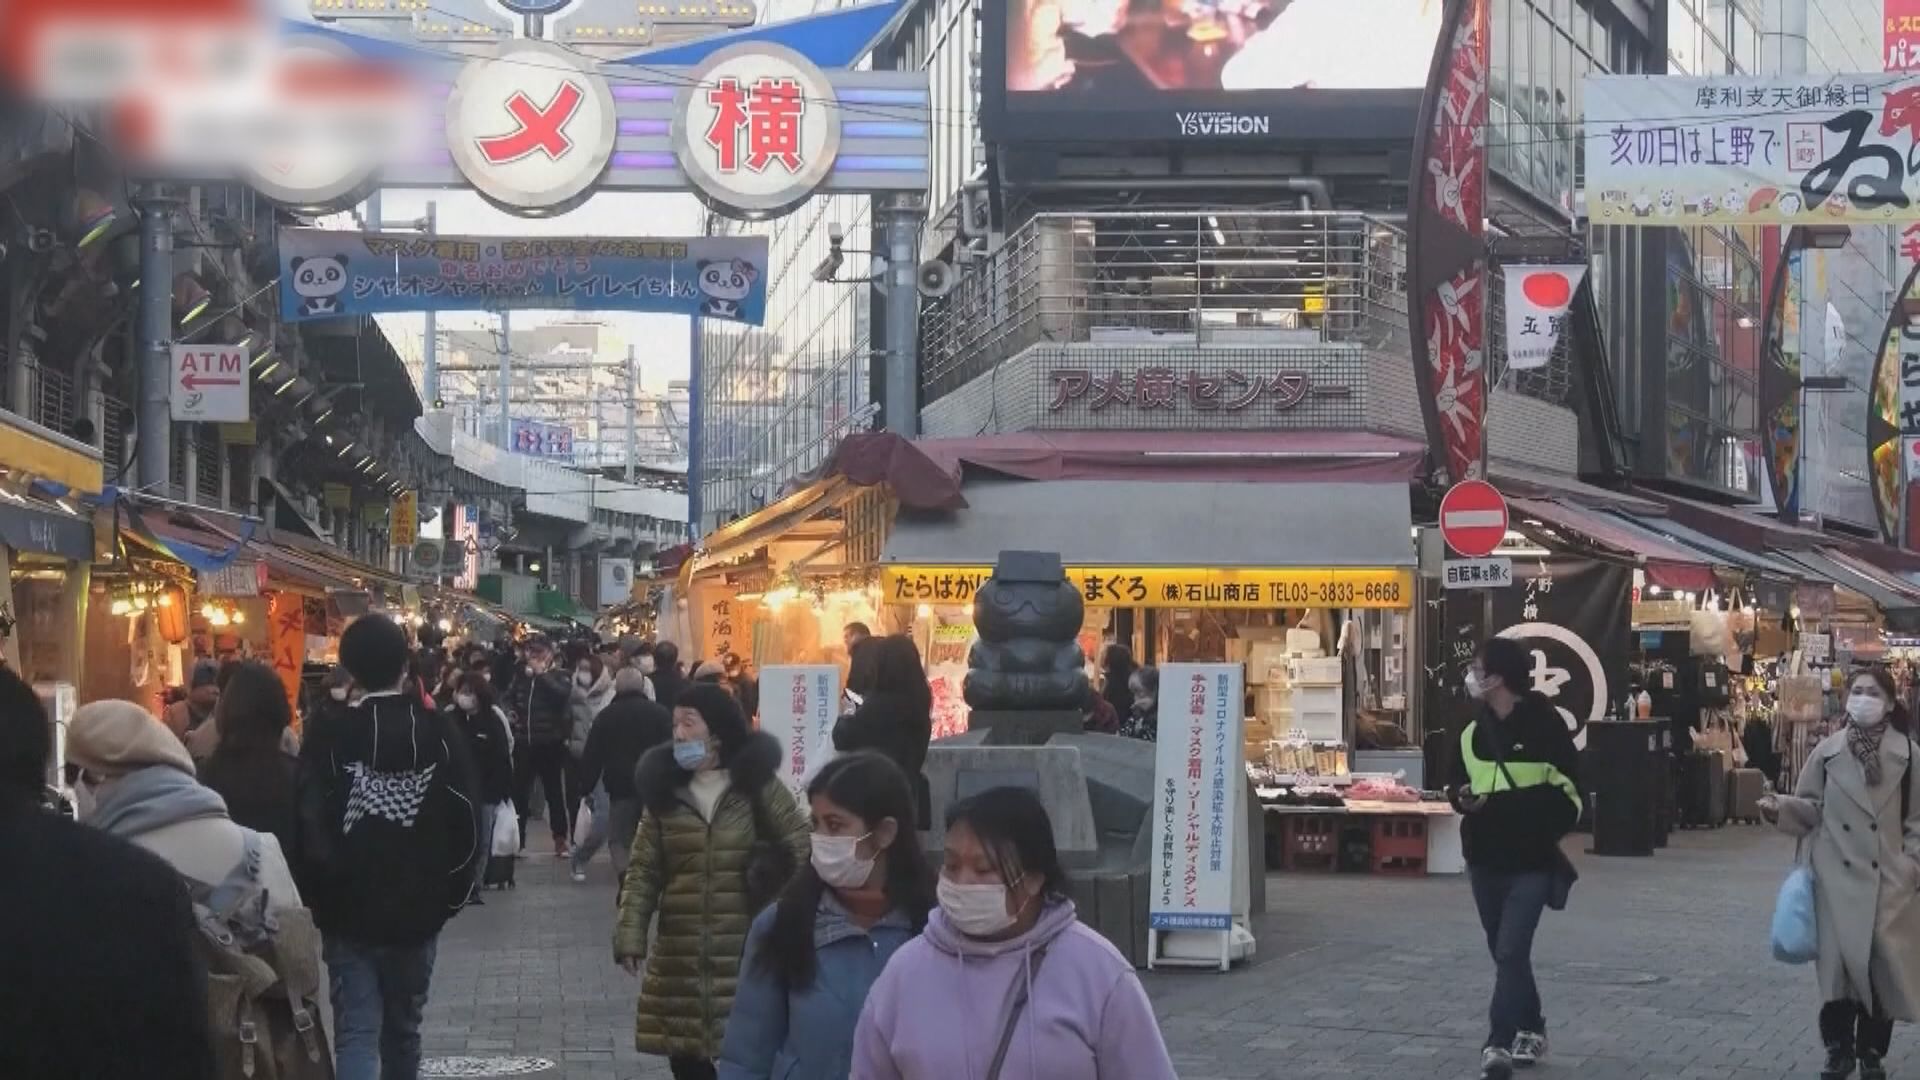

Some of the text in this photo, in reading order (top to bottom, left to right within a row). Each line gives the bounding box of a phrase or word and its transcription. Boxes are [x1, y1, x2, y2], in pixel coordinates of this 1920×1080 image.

[1695, 84, 1871, 109] 摩利支天御縁日
[1610, 124, 1781, 166] 亥の日は上野で
[1794, 128, 1816, 164] 上野
[557, 275, 698, 298] レイレイちゃん
[180, 352, 241, 373] ATM
[1049, 366, 1350, 411] アメ横センター
[1447, 564, 1509, 583] 自転車を除く
[1084, 575, 1148, 601] まぐろ
